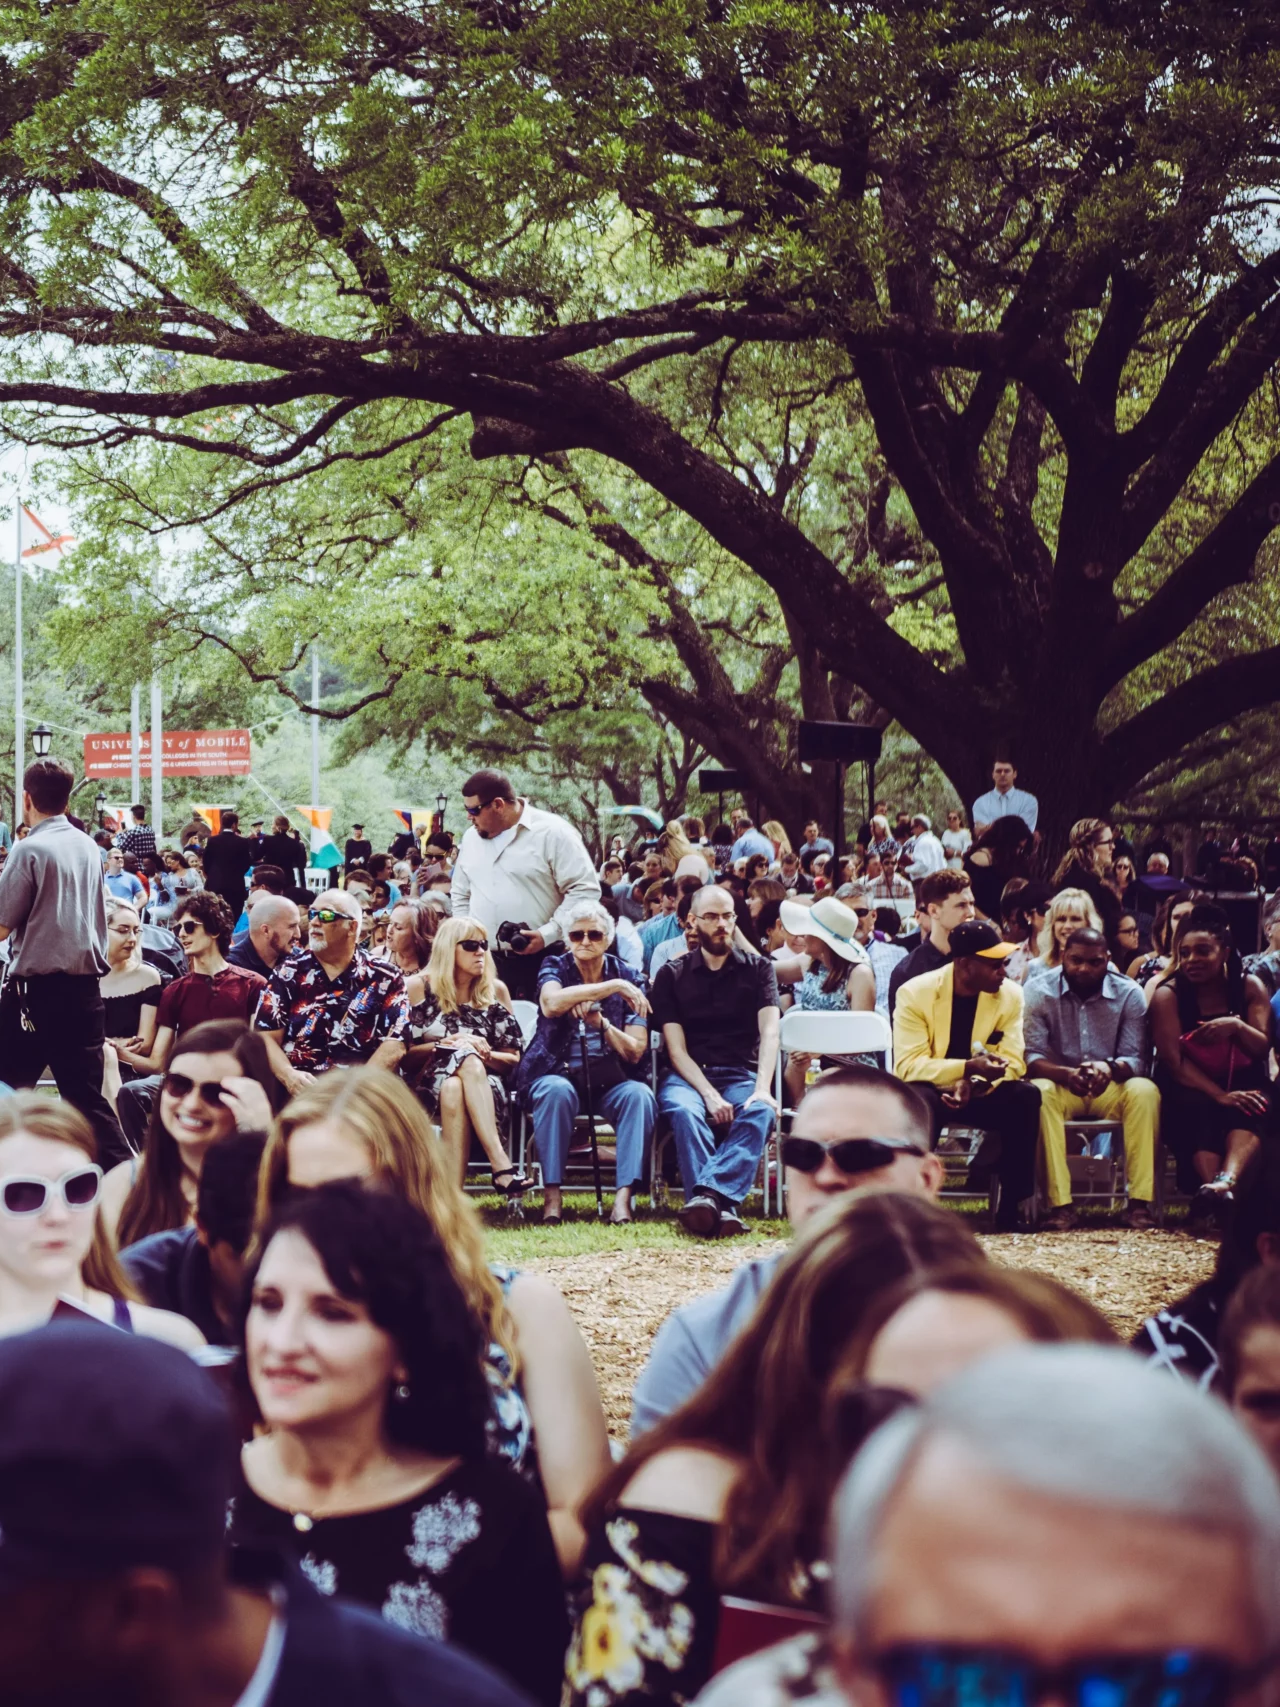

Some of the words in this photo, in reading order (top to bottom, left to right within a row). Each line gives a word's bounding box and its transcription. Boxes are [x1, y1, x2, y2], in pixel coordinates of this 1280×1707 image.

[92, 739, 173, 750] UNIVESY
[178, 739, 190, 750] of
[195, 737, 246, 747] MOBILE
